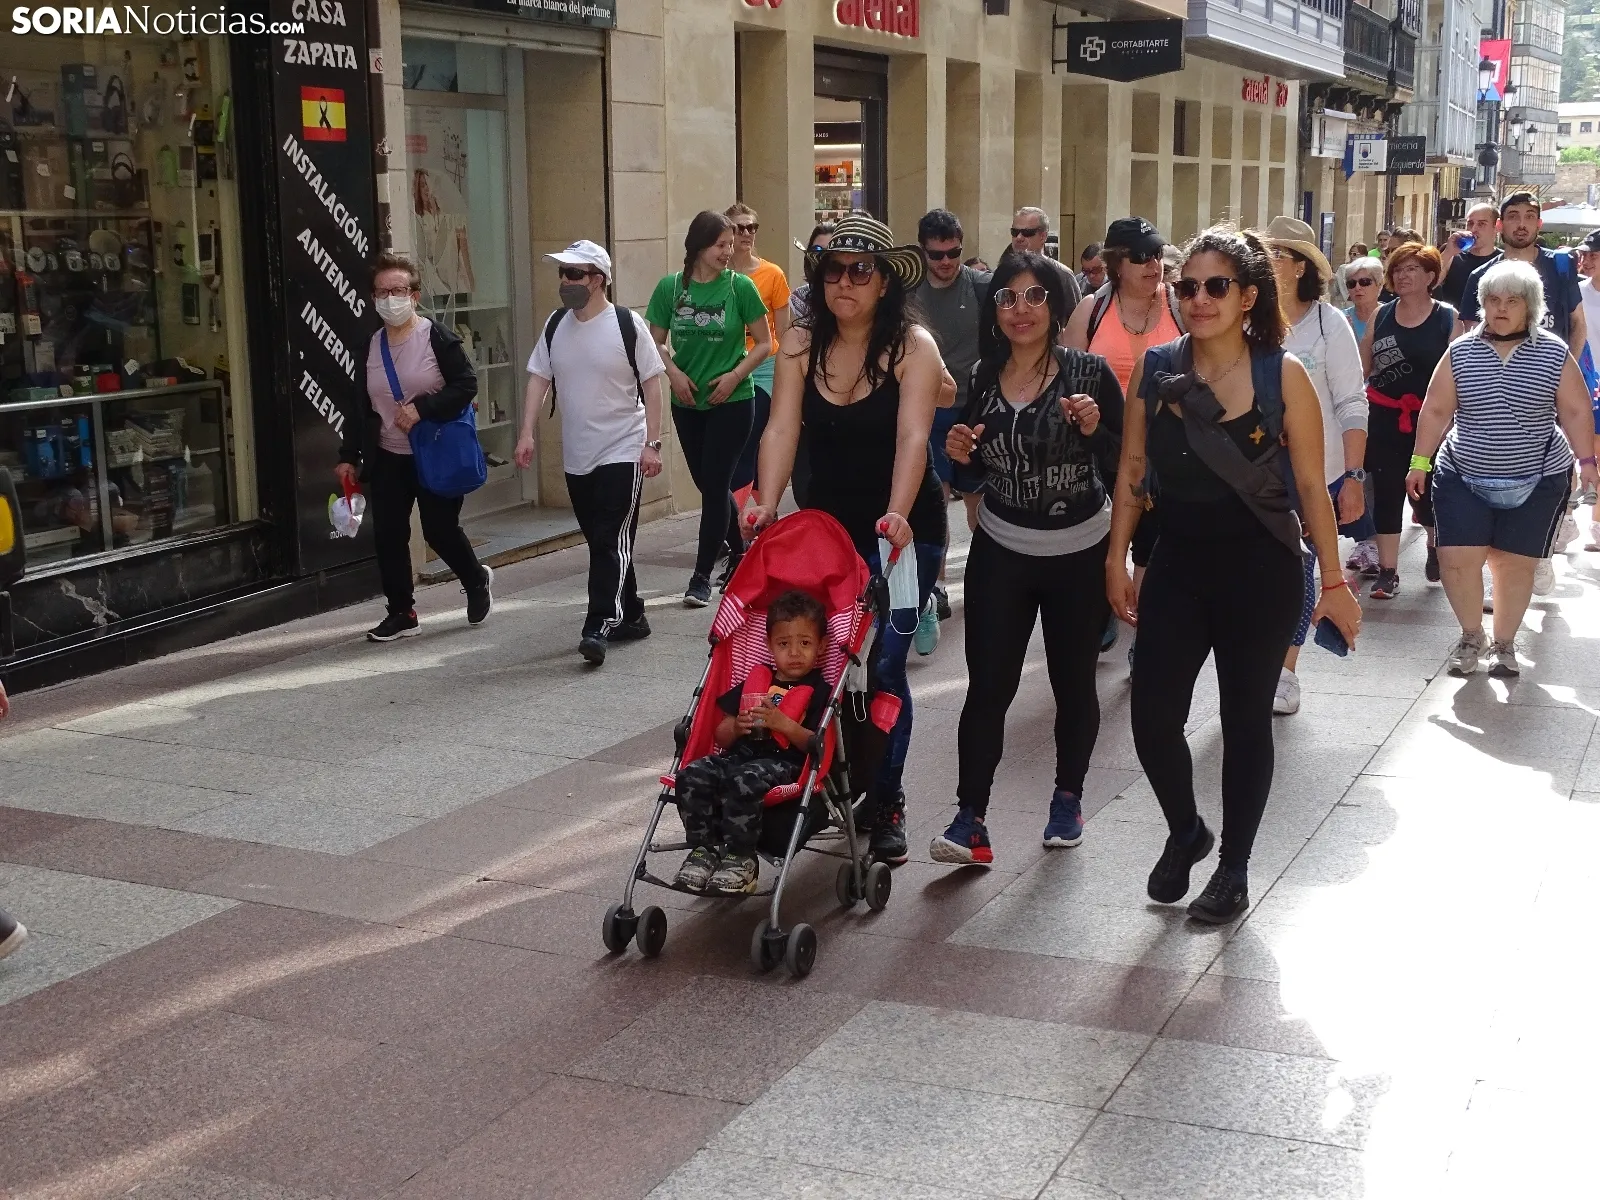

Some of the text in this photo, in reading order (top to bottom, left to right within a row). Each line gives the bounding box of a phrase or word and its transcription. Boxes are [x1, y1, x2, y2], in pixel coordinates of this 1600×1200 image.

[291, 0, 346, 26] CASA
[569, 2, 581, 15] del
[582, 4, 612, 19] perfume
[283, 38, 358, 70] ZAPATA
[1111, 39, 1170, 49] CORTABITARTE
[282, 133, 370, 259] INSTALACIÓN:
[297, 228, 366, 318] ANTENAS
[301, 301, 355, 382] INTERN
[299, 369, 345, 440] TELEVI
